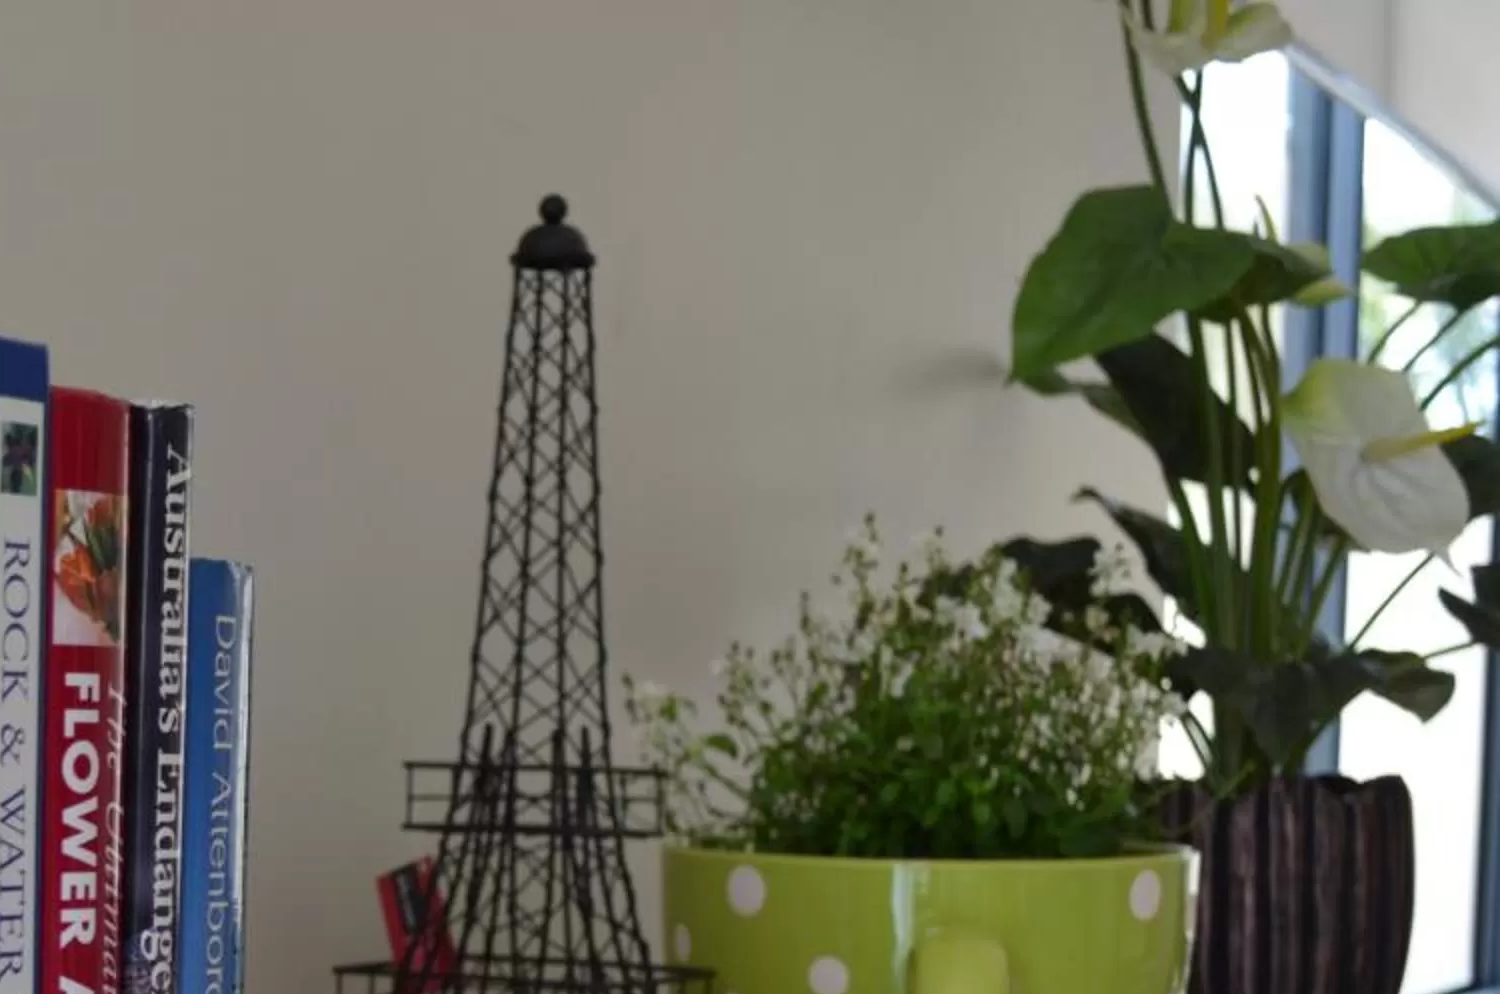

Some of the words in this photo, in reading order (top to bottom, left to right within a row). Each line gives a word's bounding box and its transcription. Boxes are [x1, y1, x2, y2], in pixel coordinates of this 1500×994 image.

[1, 537, 31, 703] ROCK
[157, 443, 191, 735] Australia's
[0, 723, 28, 768] &
[105, 684, 127, 775] The
[212, 614, 237, 751] David
[59, 672, 100, 949] FLOWER
